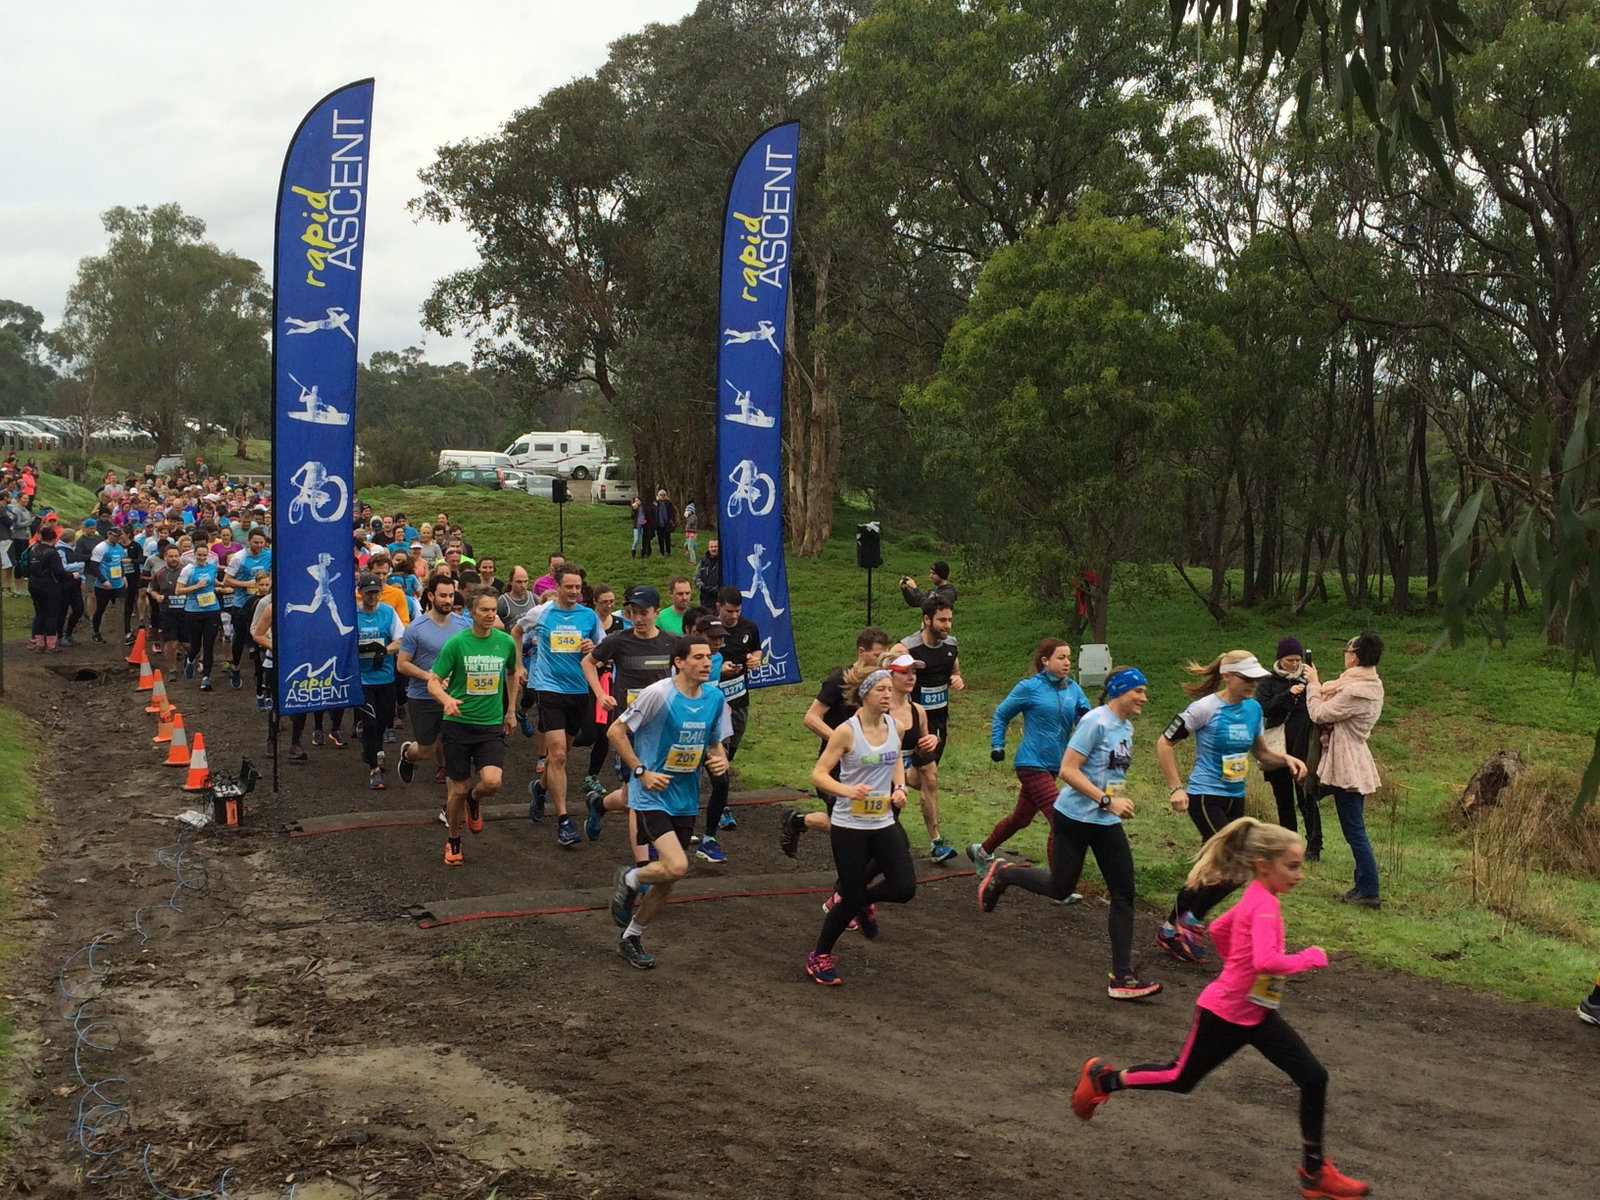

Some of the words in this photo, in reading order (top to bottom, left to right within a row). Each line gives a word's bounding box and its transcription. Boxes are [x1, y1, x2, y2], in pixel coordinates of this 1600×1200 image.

[327, 109, 365, 271] ASCENT
[759, 144, 794, 289] ASCENT
[291, 185, 336, 288] rapid
[733, 212, 768, 302] rapid
[557, 637, 575, 645] 546
[748, 661, 787, 680] CENT
[292, 671, 334, 691] rapid
[474, 679, 493, 687] 354
[724, 682, 743, 695] 8279
[285, 684, 350, 702] ASCENT
[924, 692, 945, 703] 8211
[678, 730, 706, 743] TRAIL
[676, 752, 696, 762] 209
[864, 800, 882, 810] 118
